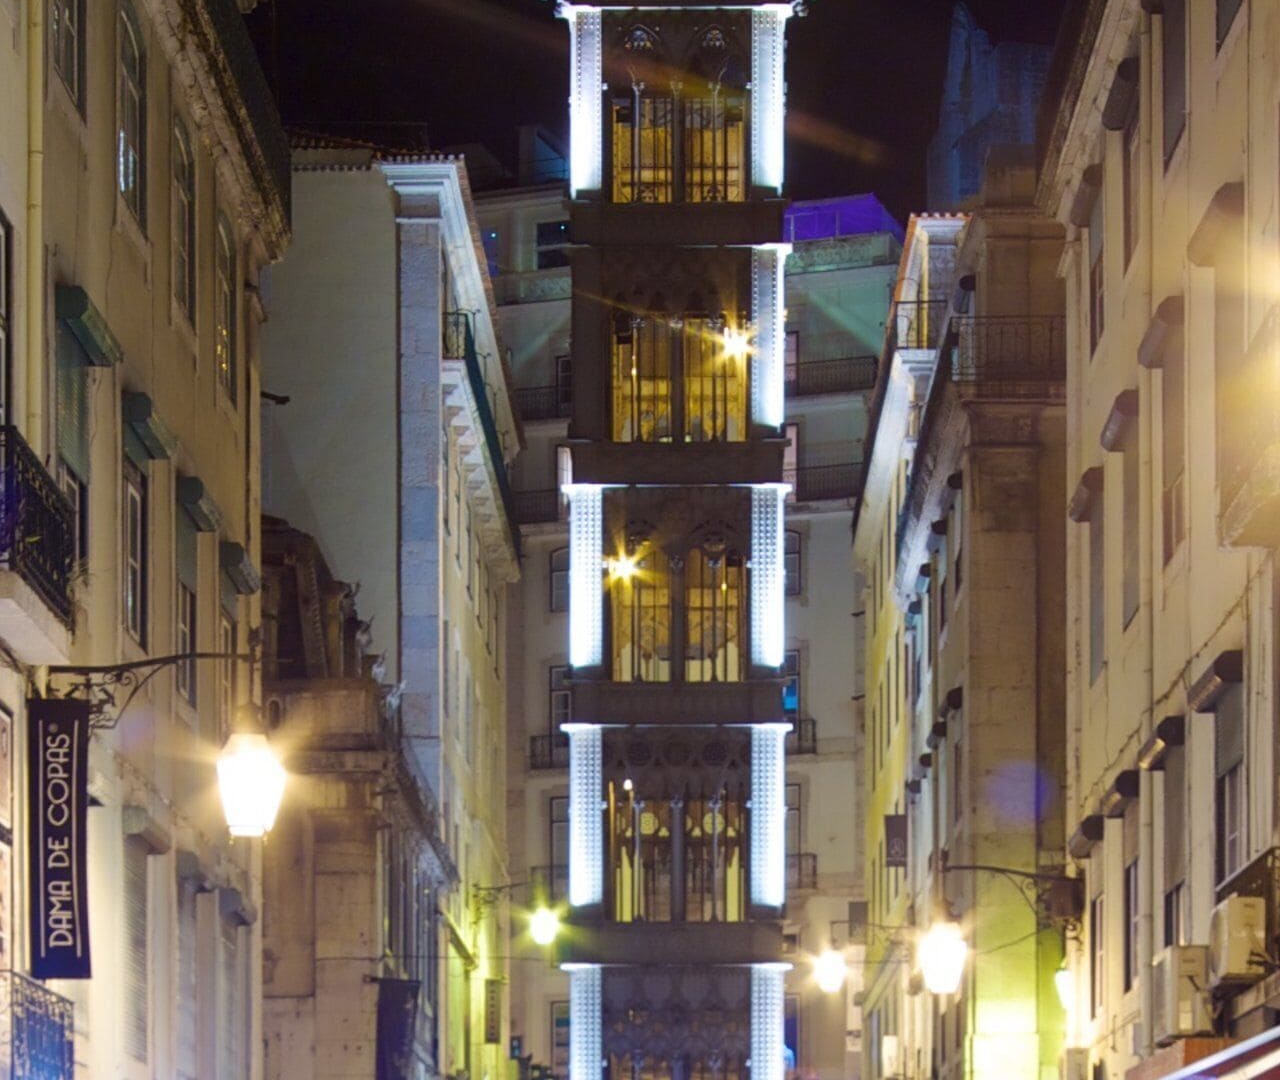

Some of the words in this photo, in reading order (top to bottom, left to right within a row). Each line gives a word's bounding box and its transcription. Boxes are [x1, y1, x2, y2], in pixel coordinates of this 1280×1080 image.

[46, 733, 71, 827] COPAS
[48, 836, 70, 869] DE
[48, 880, 74, 948] DAMA
